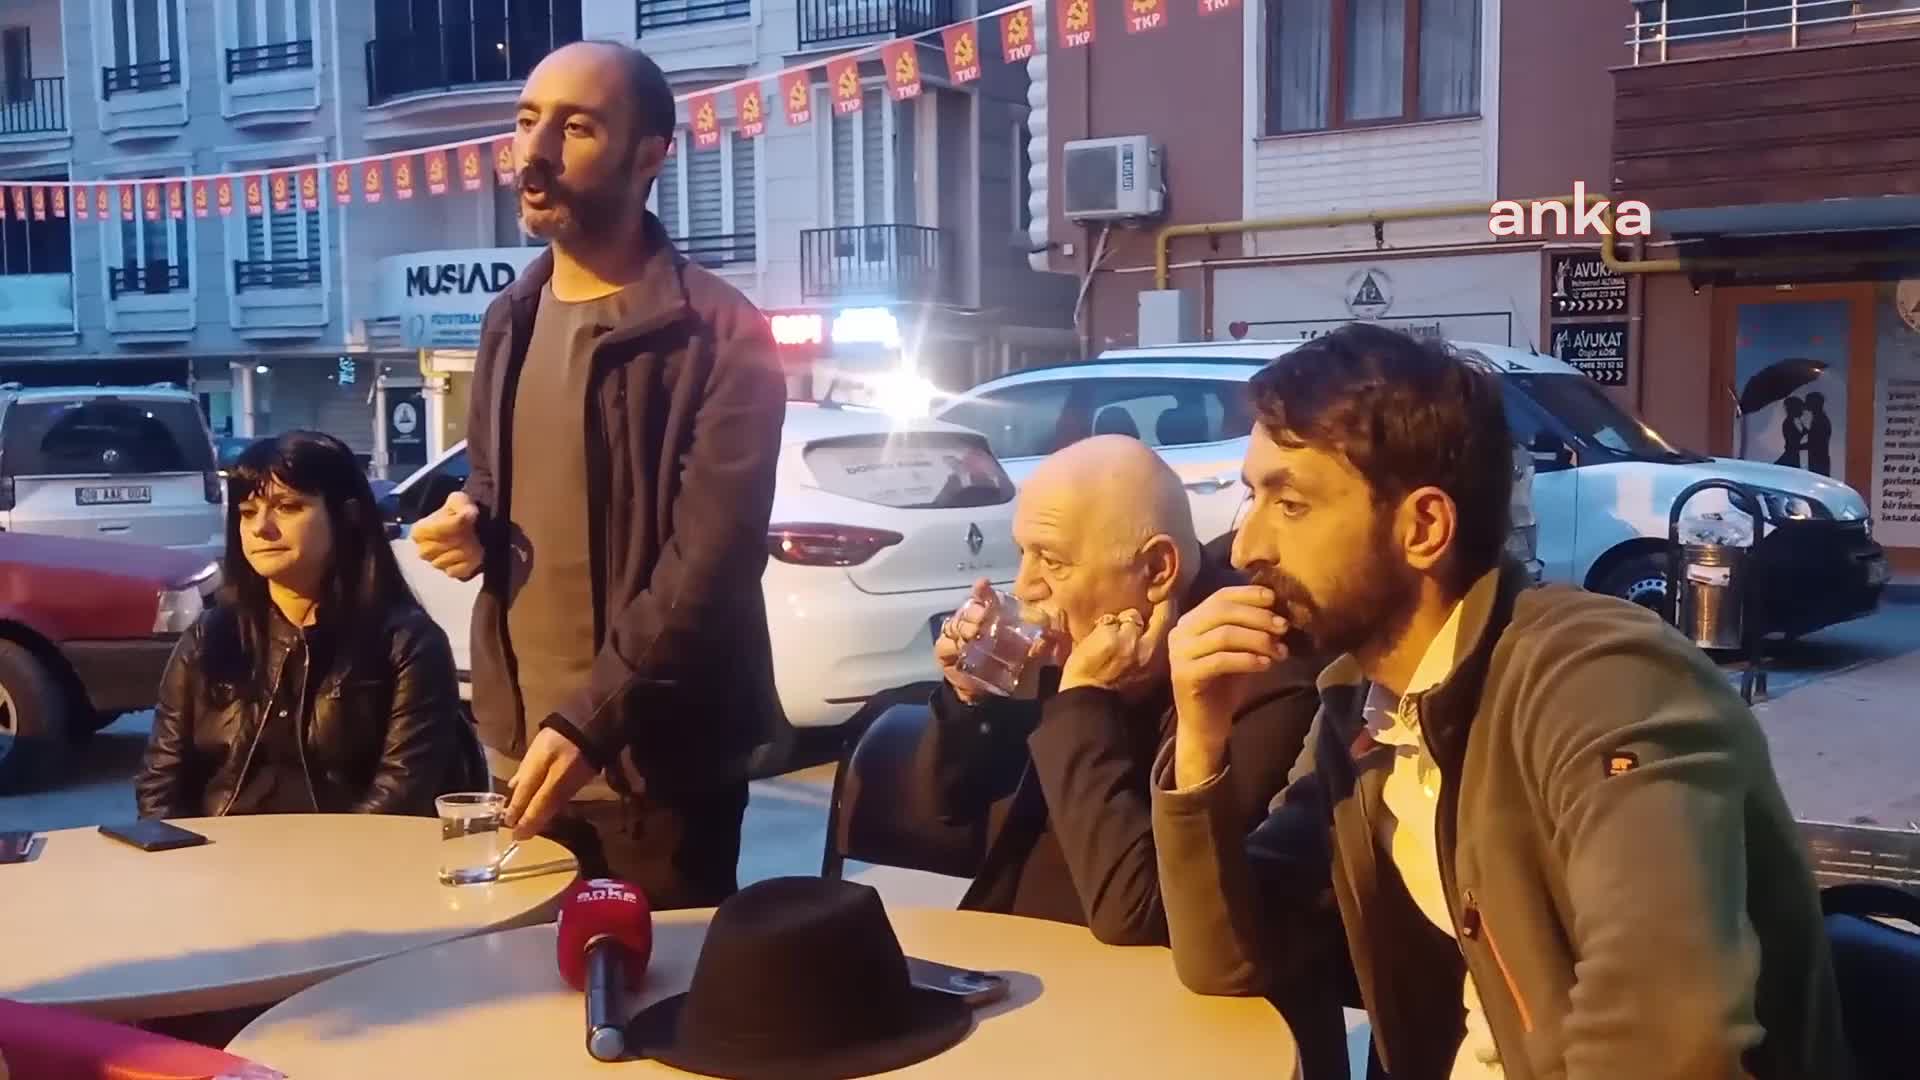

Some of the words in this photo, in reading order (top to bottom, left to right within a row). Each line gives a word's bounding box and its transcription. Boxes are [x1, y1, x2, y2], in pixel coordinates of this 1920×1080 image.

[1132, 13, 1161, 31] TKP
[1066, 31, 1091, 47] TKP
[1008, 44, 1032, 60] TKP
[956, 67, 978, 82] TKP
[897, 83, 921, 98] TKP
[840, 98, 861, 113] TKP
[791, 110, 809, 124] TKP
[744, 122, 763, 136] TKP
[699, 132, 718, 145] TKP
[1573, 331, 1623, 348] AVUKAT
